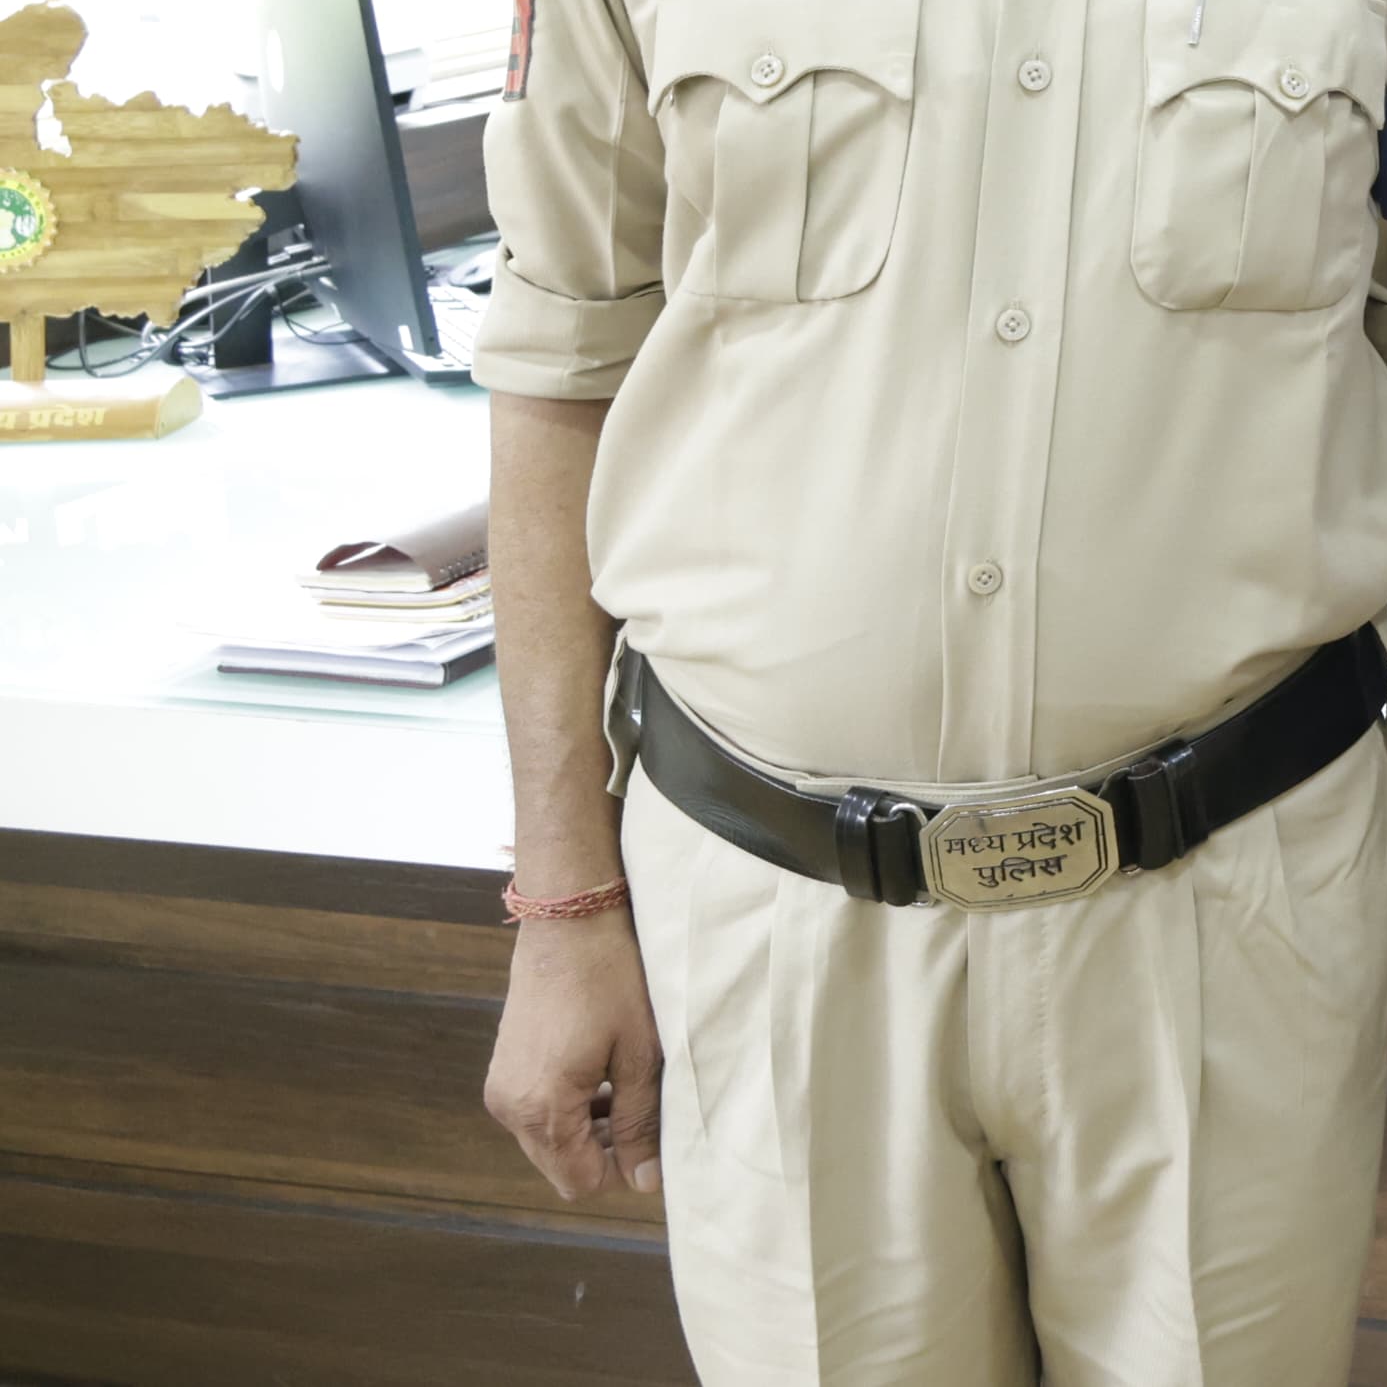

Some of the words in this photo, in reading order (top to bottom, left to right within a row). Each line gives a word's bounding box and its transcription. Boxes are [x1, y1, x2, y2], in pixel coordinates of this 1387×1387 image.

[944, 834, 1007, 855] मध्य
[1012, 818, 1086, 851] प्रदेश
[973, 854, 1067, 888] पुलिस
